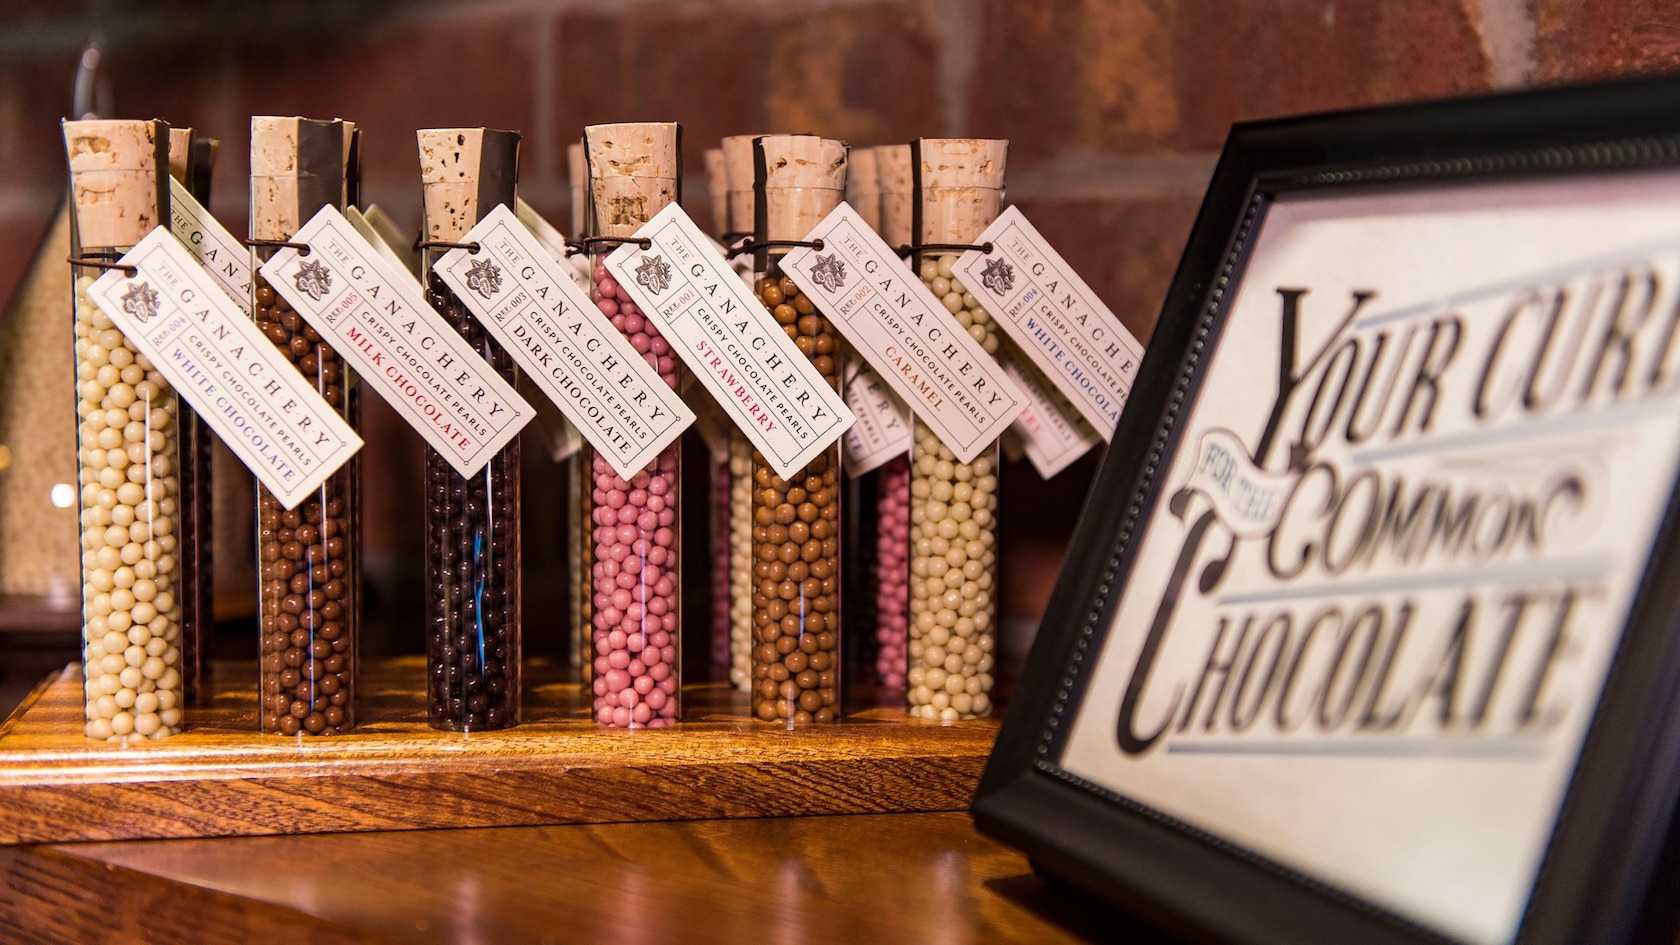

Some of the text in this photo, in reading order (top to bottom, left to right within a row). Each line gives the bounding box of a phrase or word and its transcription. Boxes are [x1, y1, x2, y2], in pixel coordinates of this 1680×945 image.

[158, 264, 180, 288] THE
[171, 210, 189, 230] THE
[328, 242, 349, 263] THE
[499, 242, 520, 263] THE
[670, 238, 690, 261] THE
[844, 236, 864, 258] THE
[1011, 239, 1031, 261] THE
[189, 335, 221, 370] CRISPY
[222, 372, 276, 430] CHOCOLATE
[276, 430, 310, 466] PEARLS
[347, 327, 471, 451] MILK CHOCOLATE
[362, 312, 486, 436] CRISPY CHOCOLATE PEARLS
[513, 325, 631, 454] DARK CHOCOLATE
[530, 311, 647, 439] CRISPY CHOCOLATE PEARLS
[696, 340, 777, 434] STRAWBERRY
[697, 308, 808, 439] CRISPY CHOCOLATE PEARLS
[874, 303, 986, 424] CRISPY CHOCOLATE PEARLS
[885, 346, 943, 412] CARAMEL
[1026, 317, 1066, 360] WHITE
[1065, 360, 1118, 421] CHOCOLA
[1041, 305, 1117, 388] CRISPY CHOCOLATE
[1251, 287, 1465, 470] YOUR
[172, 349, 295, 482] WHITE CHOCOLATE
[1267, 461, 1587, 581] COMMON
[1115, 488, 1602, 761] CHOCOLATE
